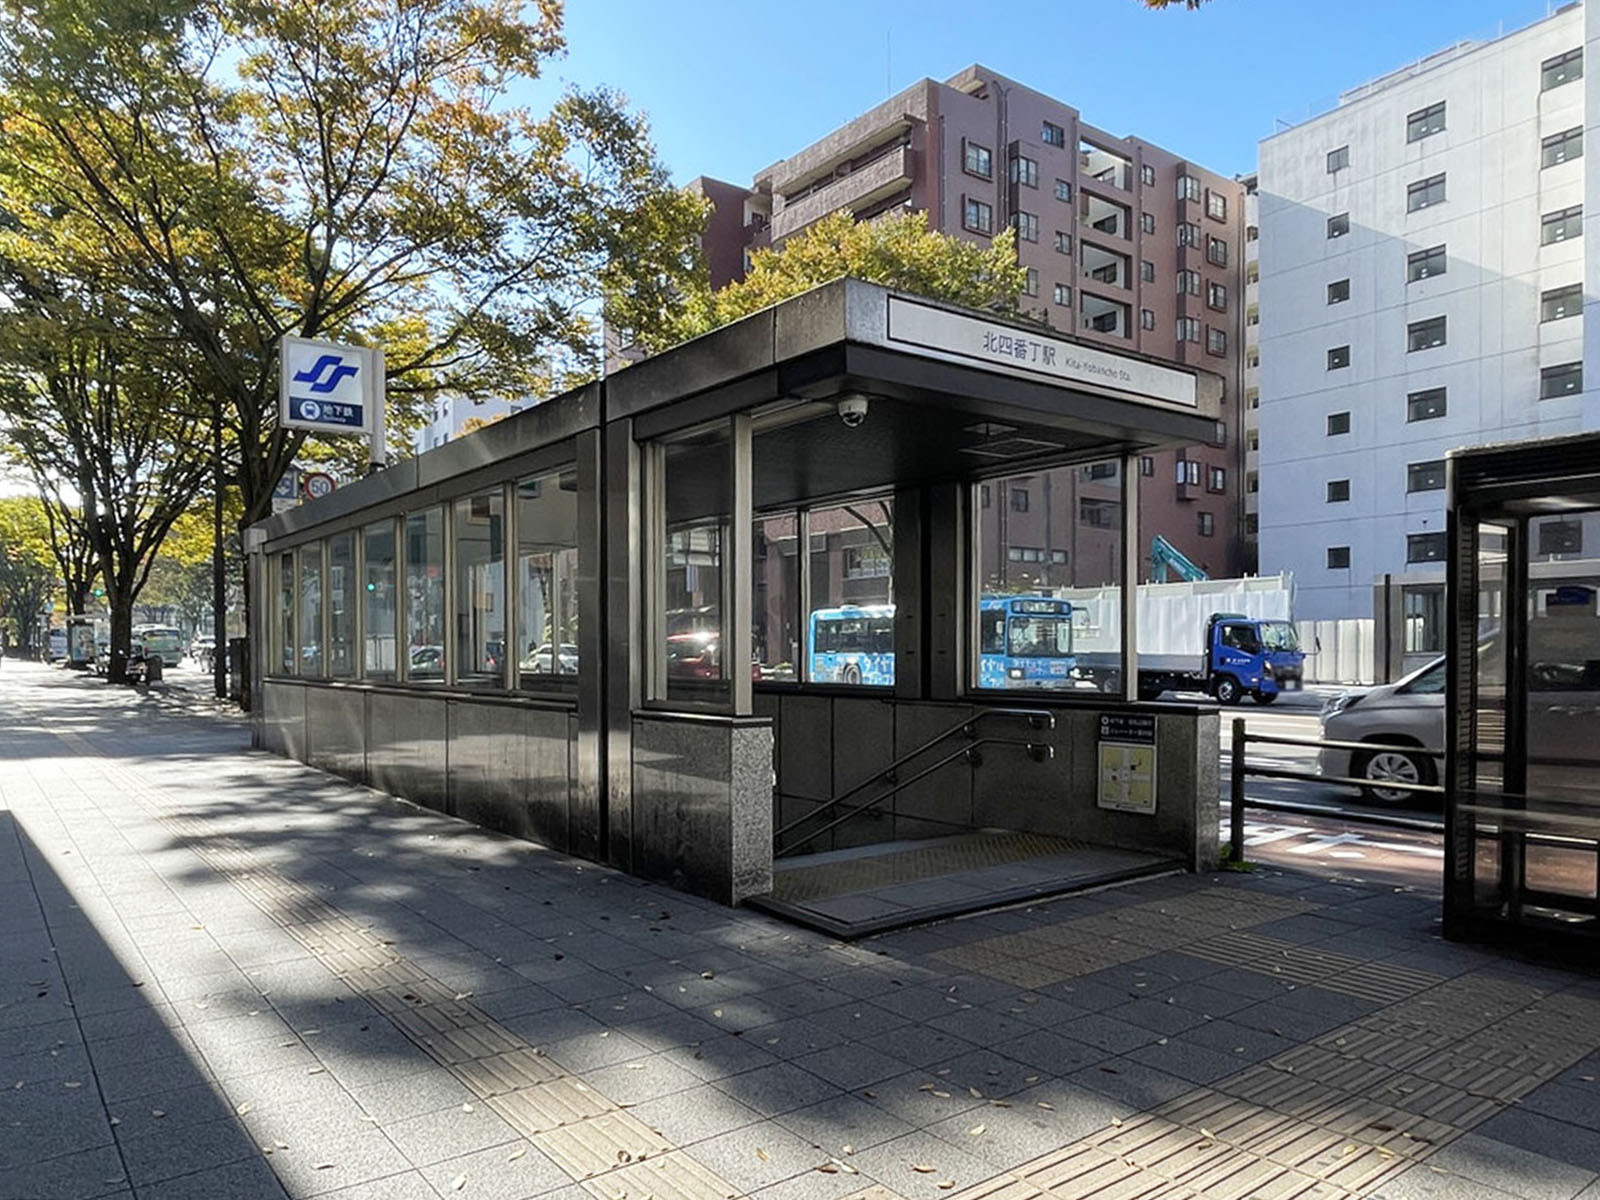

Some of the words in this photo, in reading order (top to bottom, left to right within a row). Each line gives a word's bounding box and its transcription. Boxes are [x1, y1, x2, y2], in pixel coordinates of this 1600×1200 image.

[983, 331, 1056, 366] 北四番丁駅
[311, 480, 329, 494] 50
